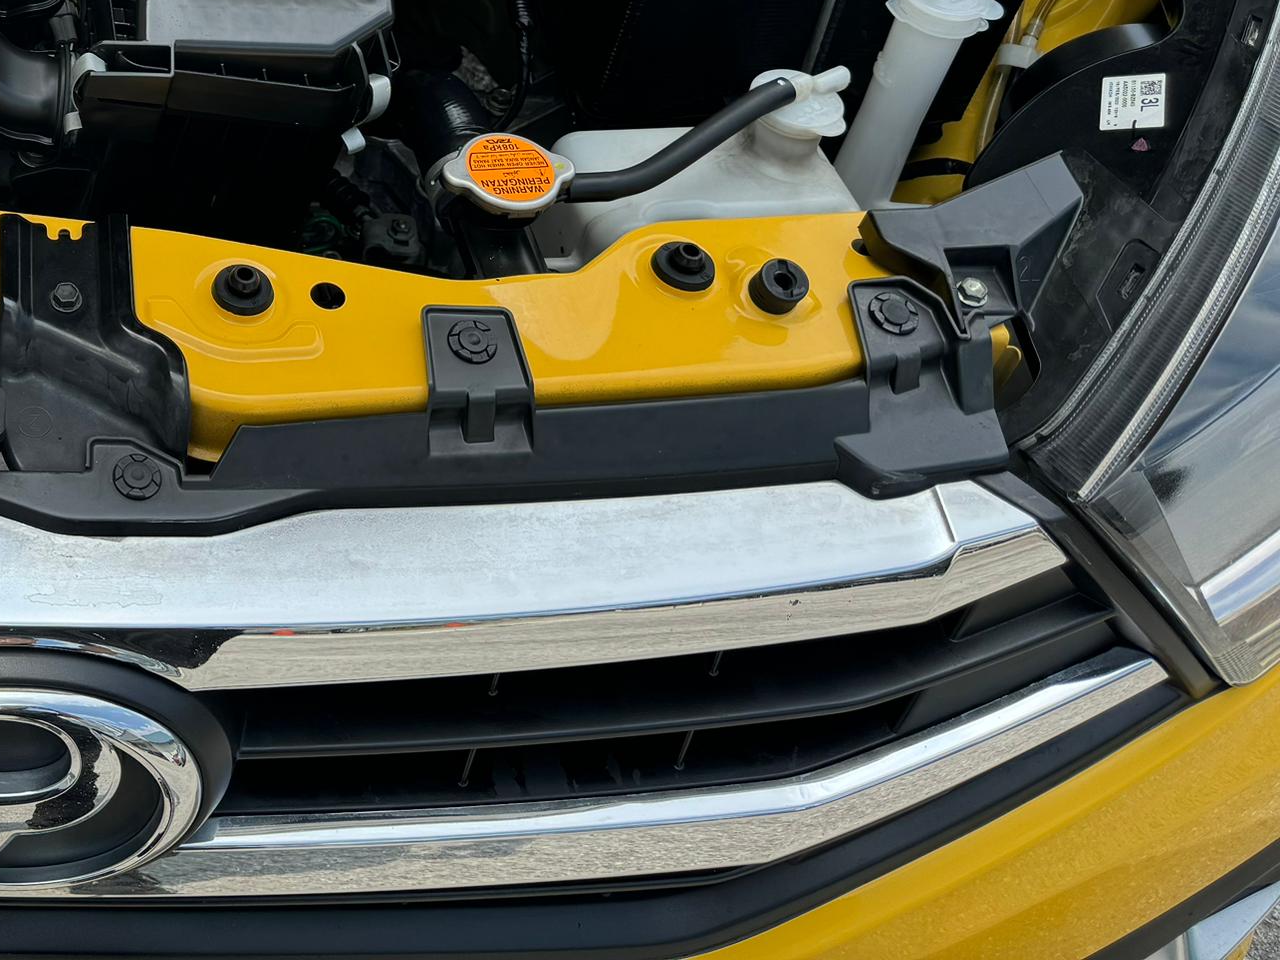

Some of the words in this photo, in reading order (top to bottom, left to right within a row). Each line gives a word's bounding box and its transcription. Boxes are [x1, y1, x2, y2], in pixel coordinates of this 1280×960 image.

[1140, 97, 1159, 112] 3L
[483, 143, 520, 151] 108kPa
[481, 177, 550, 187] PERINGATAN
[493, 185, 545, 195] WARNING
